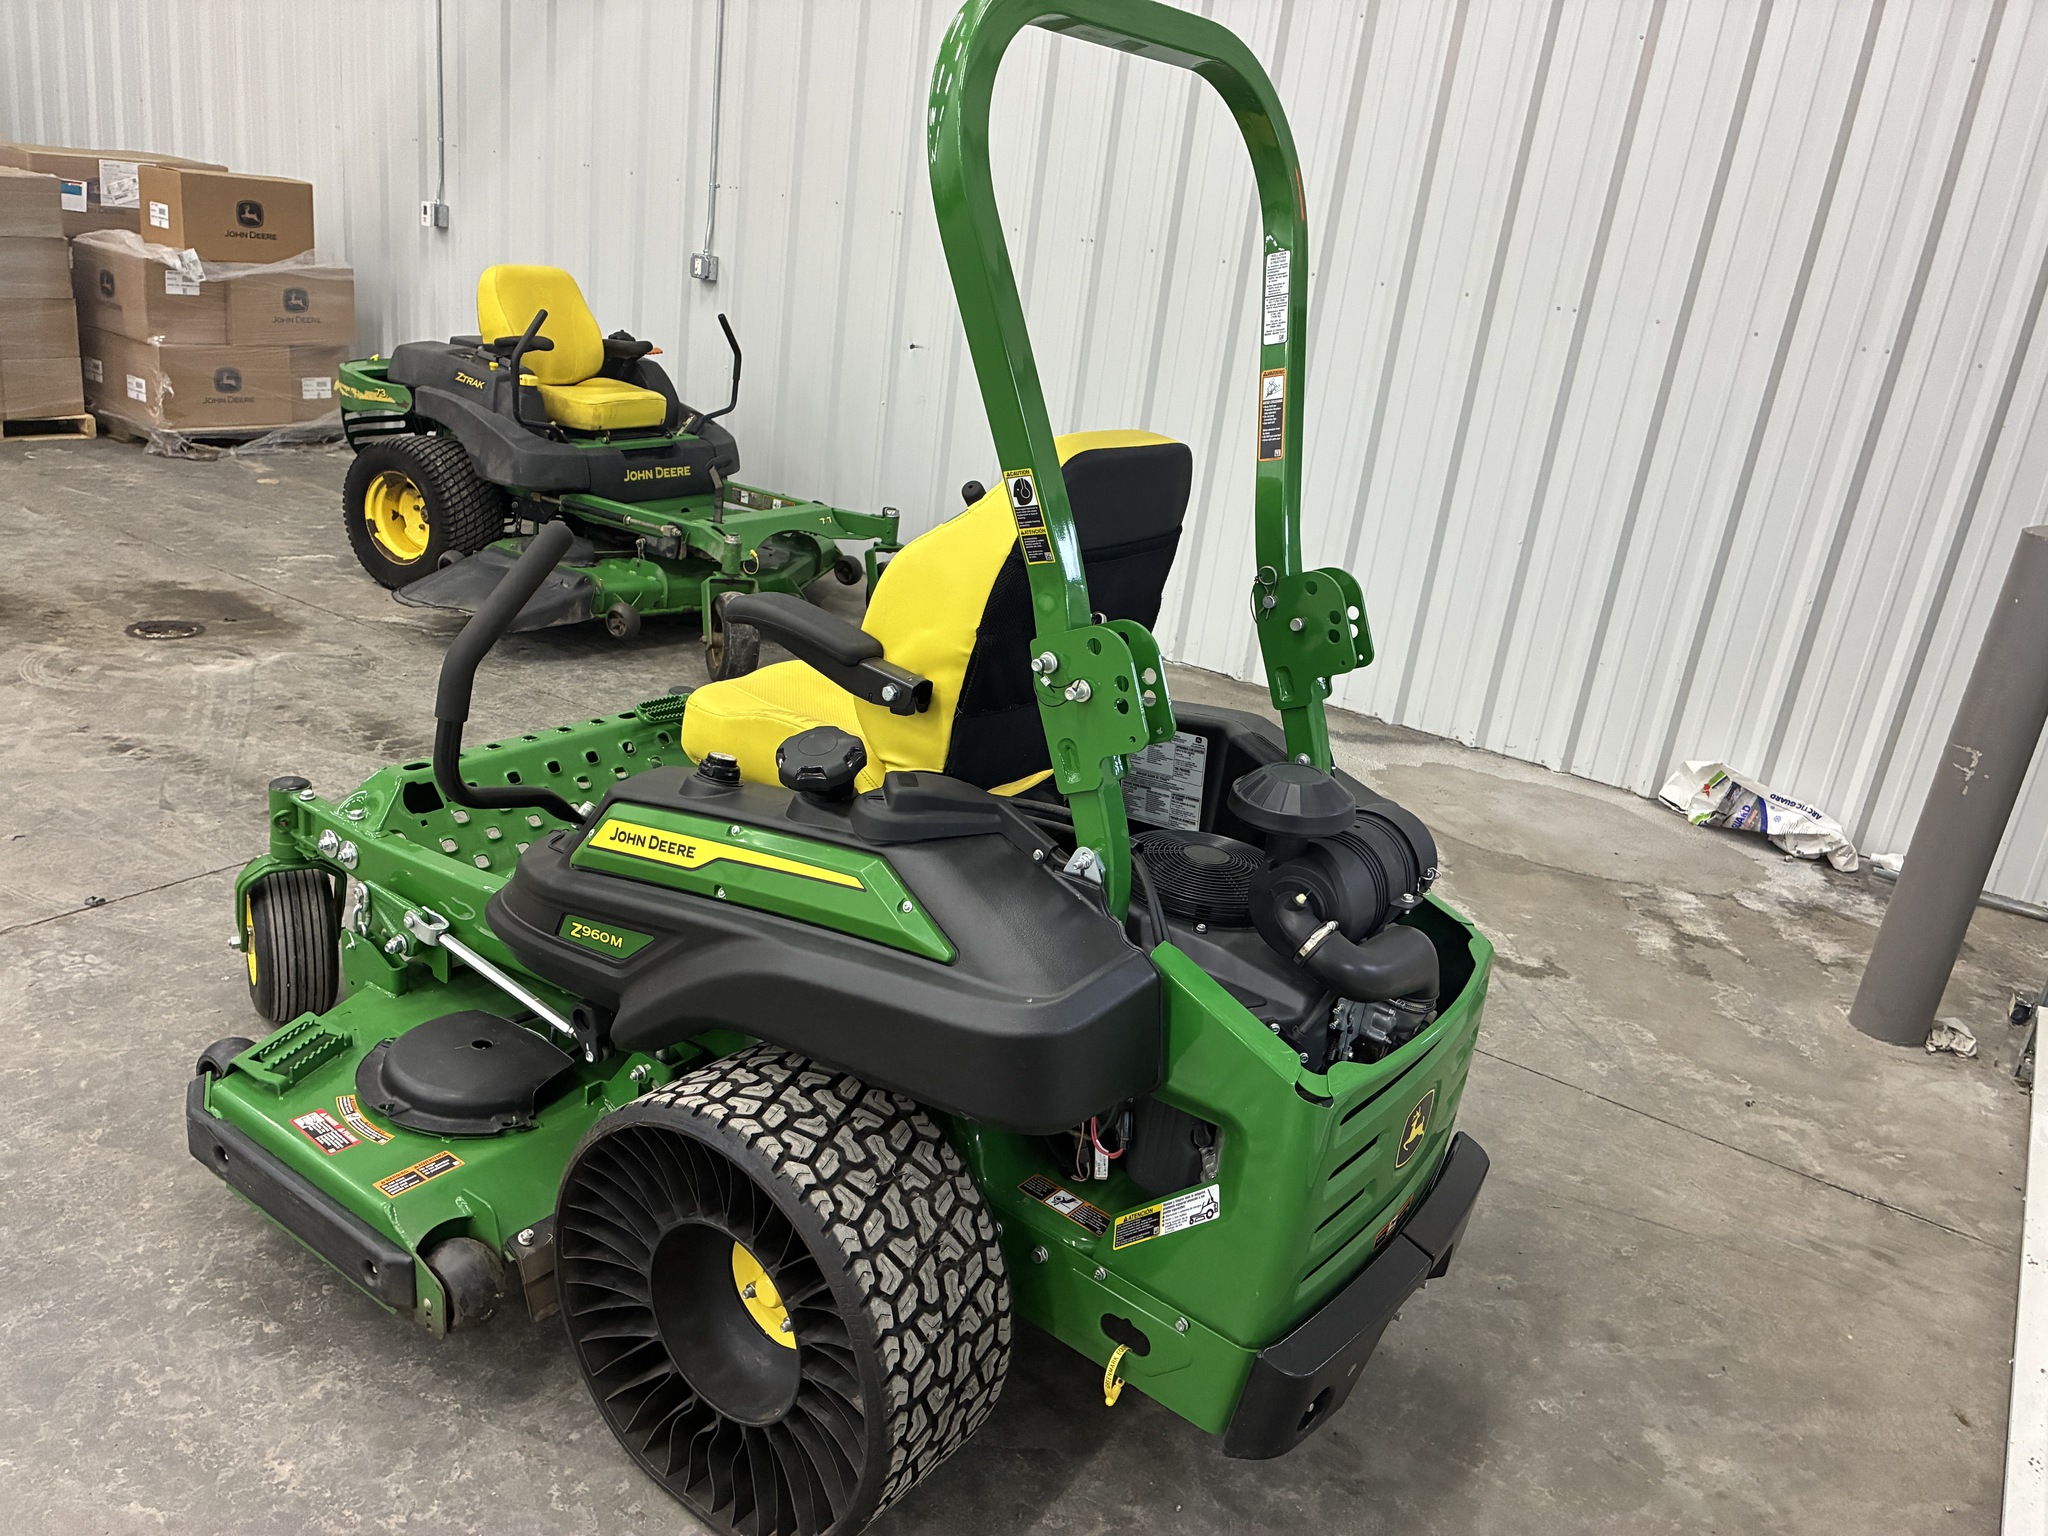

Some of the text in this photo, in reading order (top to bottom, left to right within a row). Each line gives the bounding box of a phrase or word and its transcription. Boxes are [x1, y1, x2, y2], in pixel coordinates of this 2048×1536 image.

[224, 229, 278, 241] JOHN DEERE
[455, 372, 486, 390] ZTRAK
[202, 396, 255, 405] JOHN DEERE
[623, 465, 692, 482] JOHN DEERE
[1010, 469, 1030, 477] CAUTION
[1024, 527, 1046, 535] ATENCIÓN
[1769, 792, 1823, 820] ARCTIC GUARD
[610, 827, 696, 859] JOHN DEERE
[570, 922, 623, 948] Z960M
[1128, 1207, 1154, 1220] ATENCIÓN
